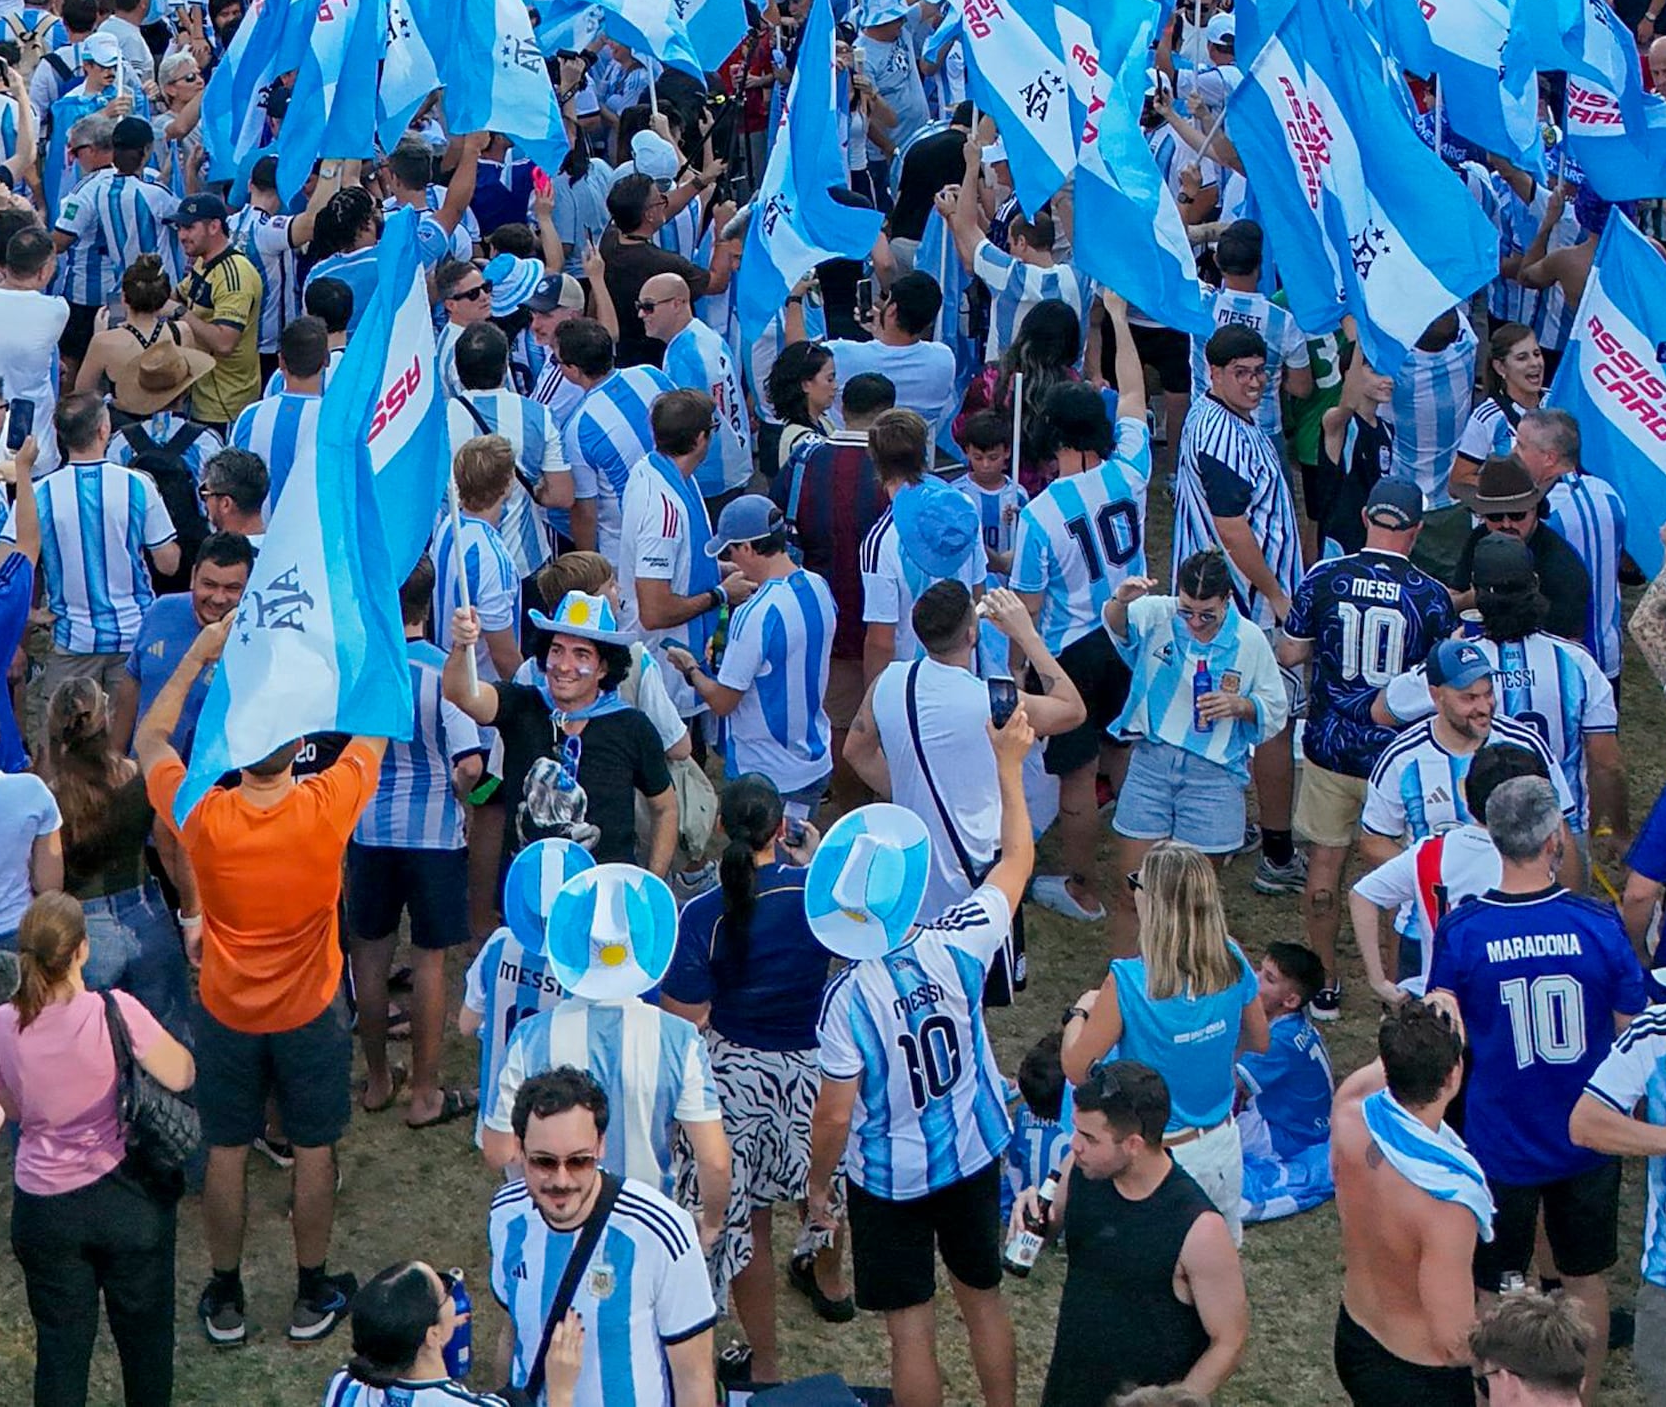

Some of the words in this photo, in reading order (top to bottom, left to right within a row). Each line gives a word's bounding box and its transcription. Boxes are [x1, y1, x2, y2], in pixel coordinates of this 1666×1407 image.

[1019, 76, 1052, 122] AFA
[1219, 308, 1262, 331] MESSI
[724, 372, 746, 449] PLAGA
[1064, 497, 1142, 583] 10
[1351, 578, 1402, 602] MESSI
[1338, 602, 1407, 686] 10
[1486, 934, 1582, 964] MARADONA
[500, 960, 563, 997] MESSI
[894, 983, 945, 1021] MESSI
[1499, 975, 1586, 1071] 10
[897, 1015, 961, 1111] 10
